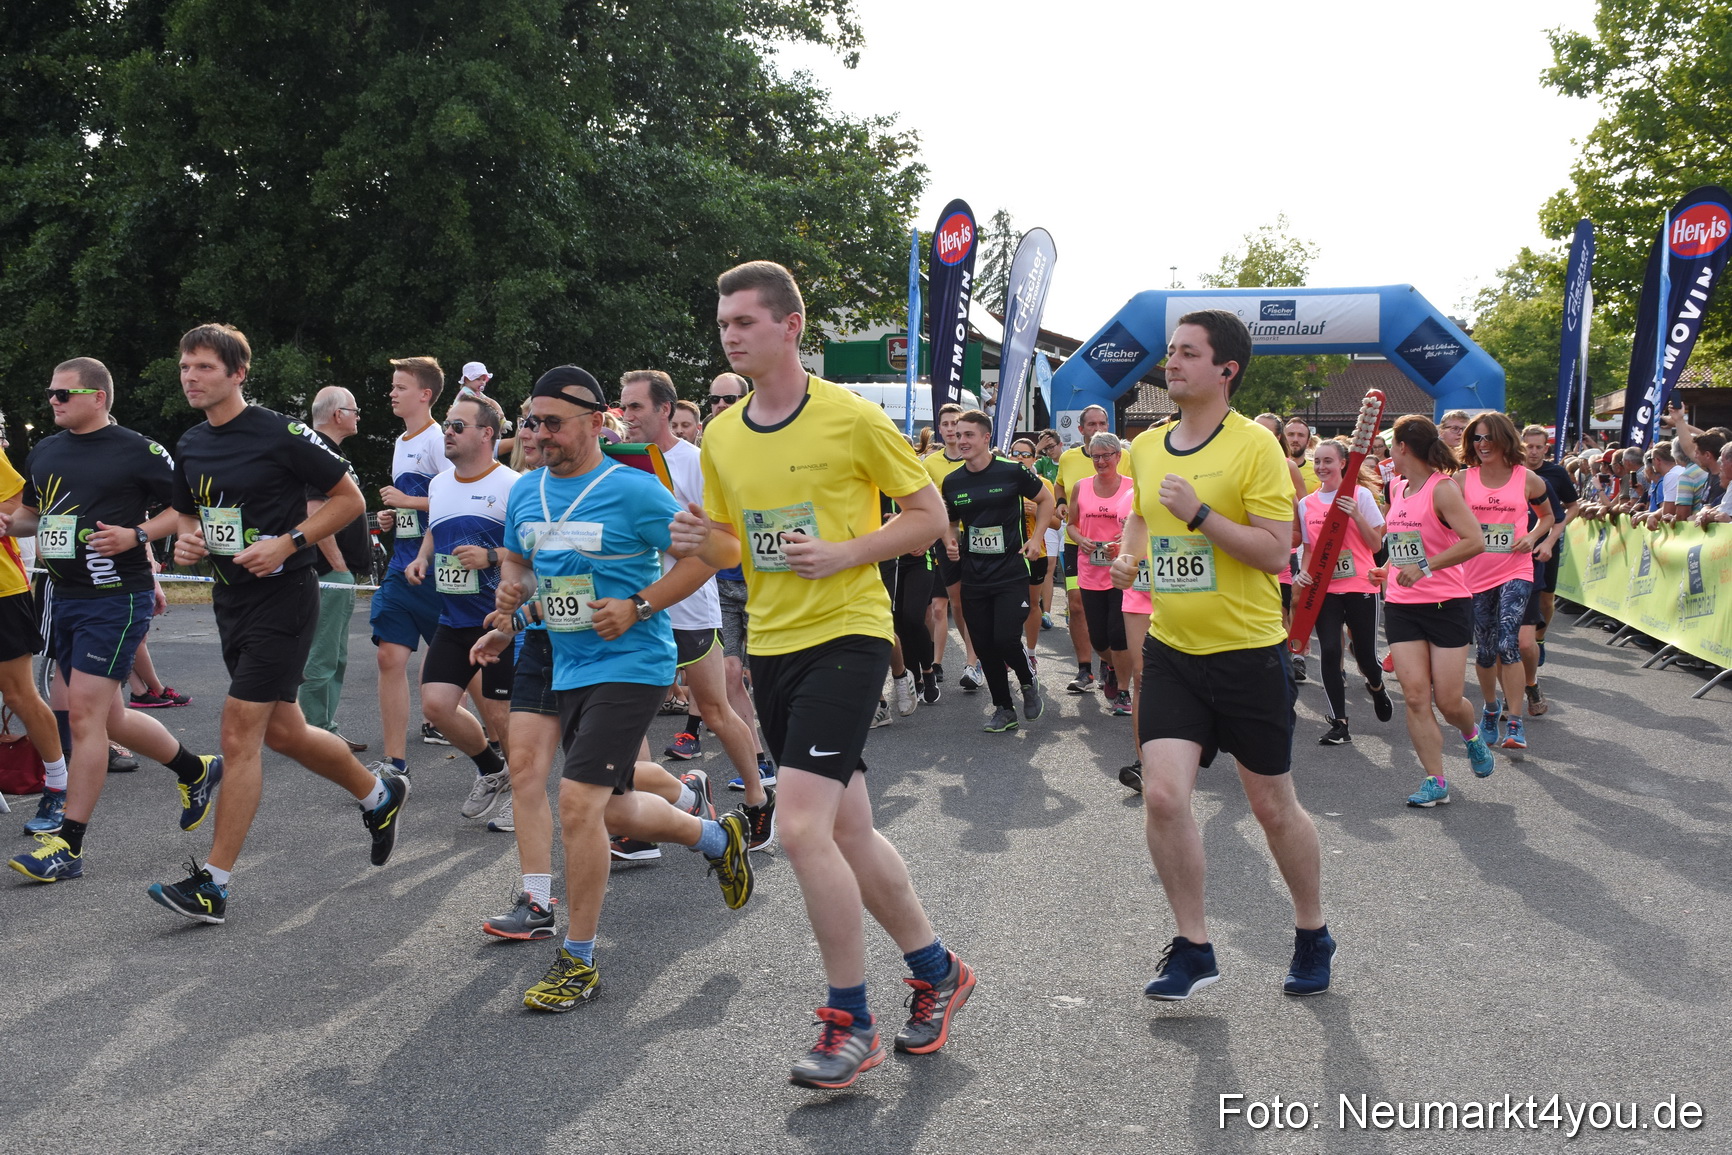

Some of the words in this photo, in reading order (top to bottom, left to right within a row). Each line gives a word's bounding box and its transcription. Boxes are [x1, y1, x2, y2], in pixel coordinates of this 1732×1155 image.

[1672, 214, 1727, 245] Hervis
[939, 223, 971, 255] Hervis
[1029, 256, 1048, 315] AUTOMOBILE
[1247, 320, 1327, 336] firmenlauf
[1098, 349, 1140, 358] Fischer
[396, 515, 414, 529] 424
[1398, 510, 1407, 518] Die
[39, 530, 68, 547] 1755
[971, 536, 998, 546] 2101
[1484, 534, 1509, 545] 119
[1391, 543, 1419, 557] 1118
[1156, 556, 1205, 577] 2186
[438, 568, 470, 583] 2127
[1304, 571, 1323, 611] HOFMANN
[547, 596, 579, 617] 839
